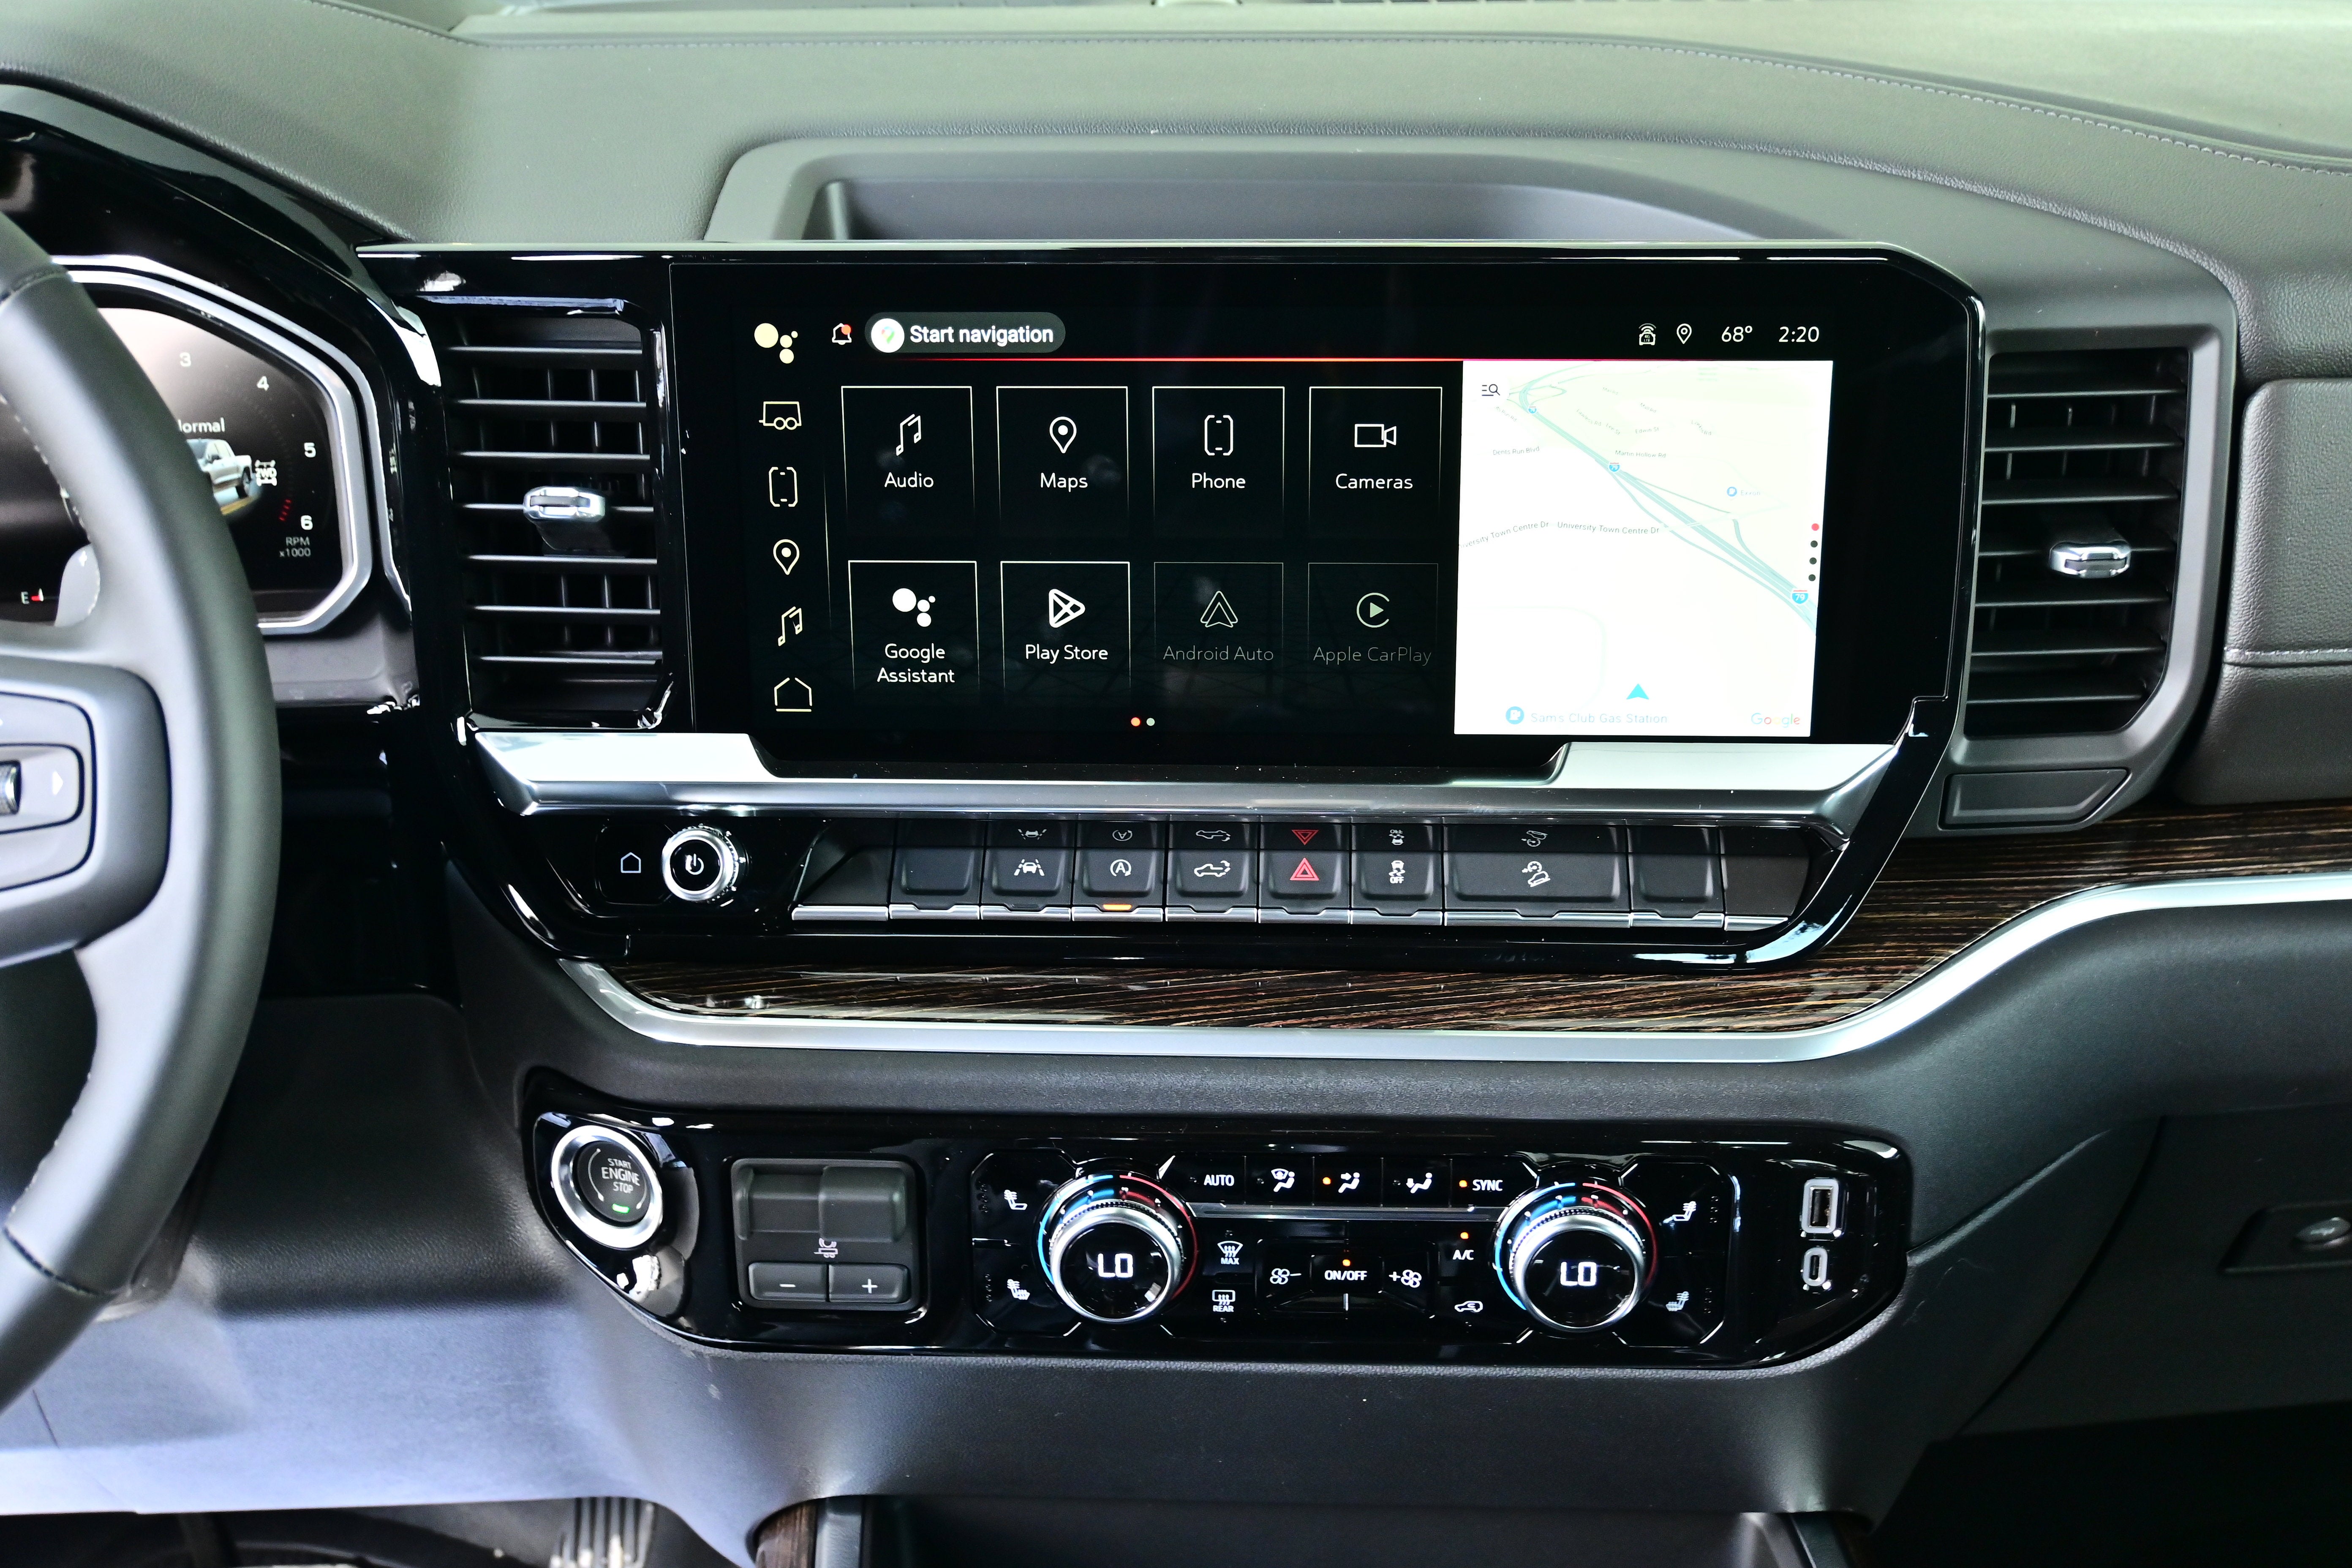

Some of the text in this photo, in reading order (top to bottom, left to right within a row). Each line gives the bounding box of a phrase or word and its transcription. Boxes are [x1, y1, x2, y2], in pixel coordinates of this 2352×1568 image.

[910, 325, 1054, 346] Start navigation
[1779, 326, 1819, 343] 2:20
[180, 353, 191, 367] 3
[257, 376, 269, 390] 4
[304, 443, 316, 458] 5
[255, 468, 277, 478] 2WD
[885, 472, 934, 488] Audio
[1192, 472, 1246, 489] Phone
[1040, 473, 1088, 493] Maps
[1336, 473, 1413, 489] Cameras
[300, 515, 313, 530] 6
[1557, 521, 1596, 533] University
[1599, 525, 1620, 534] Town
[1491, 528, 1511, 539] Town
[1513, 523, 1538, 533] Centre
[286, 536, 310, 546] RPM
[279, 547, 311, 558] x1000
[21, 591, 30, 604] E
[885, 643, 945, 664] Google
[1026, 644, 1108, 664] Play Store
[1163, 645, 1274, 661] Android Auto
[1313, 646, 1432, 666] Apple CarPlay
[877, 667, 955, 683] Assistant
[1568, 712, 1595, 724] Club
[1600, 713, 1621, 724] Gas
[1625, 713, 1667, 724] Station
[1751, 712, 1800, 728] Google
[607, 1158, 632, 1170] START
[601, 1167, 640, 1186] ENGINE
[1204, 1174, 1235, 1186] AUTO
[613, 1181, 634, 1194] STOP
[1473, 1179, 1503, 1192] SYNC
[1453, 1250, 1474, 1260] A/C
[1098, 1253, 1133, 1278] LO
[1324, 1270, 1367, 1281] ON/OFF
[1560, 1261, 1597, 1287] LO
